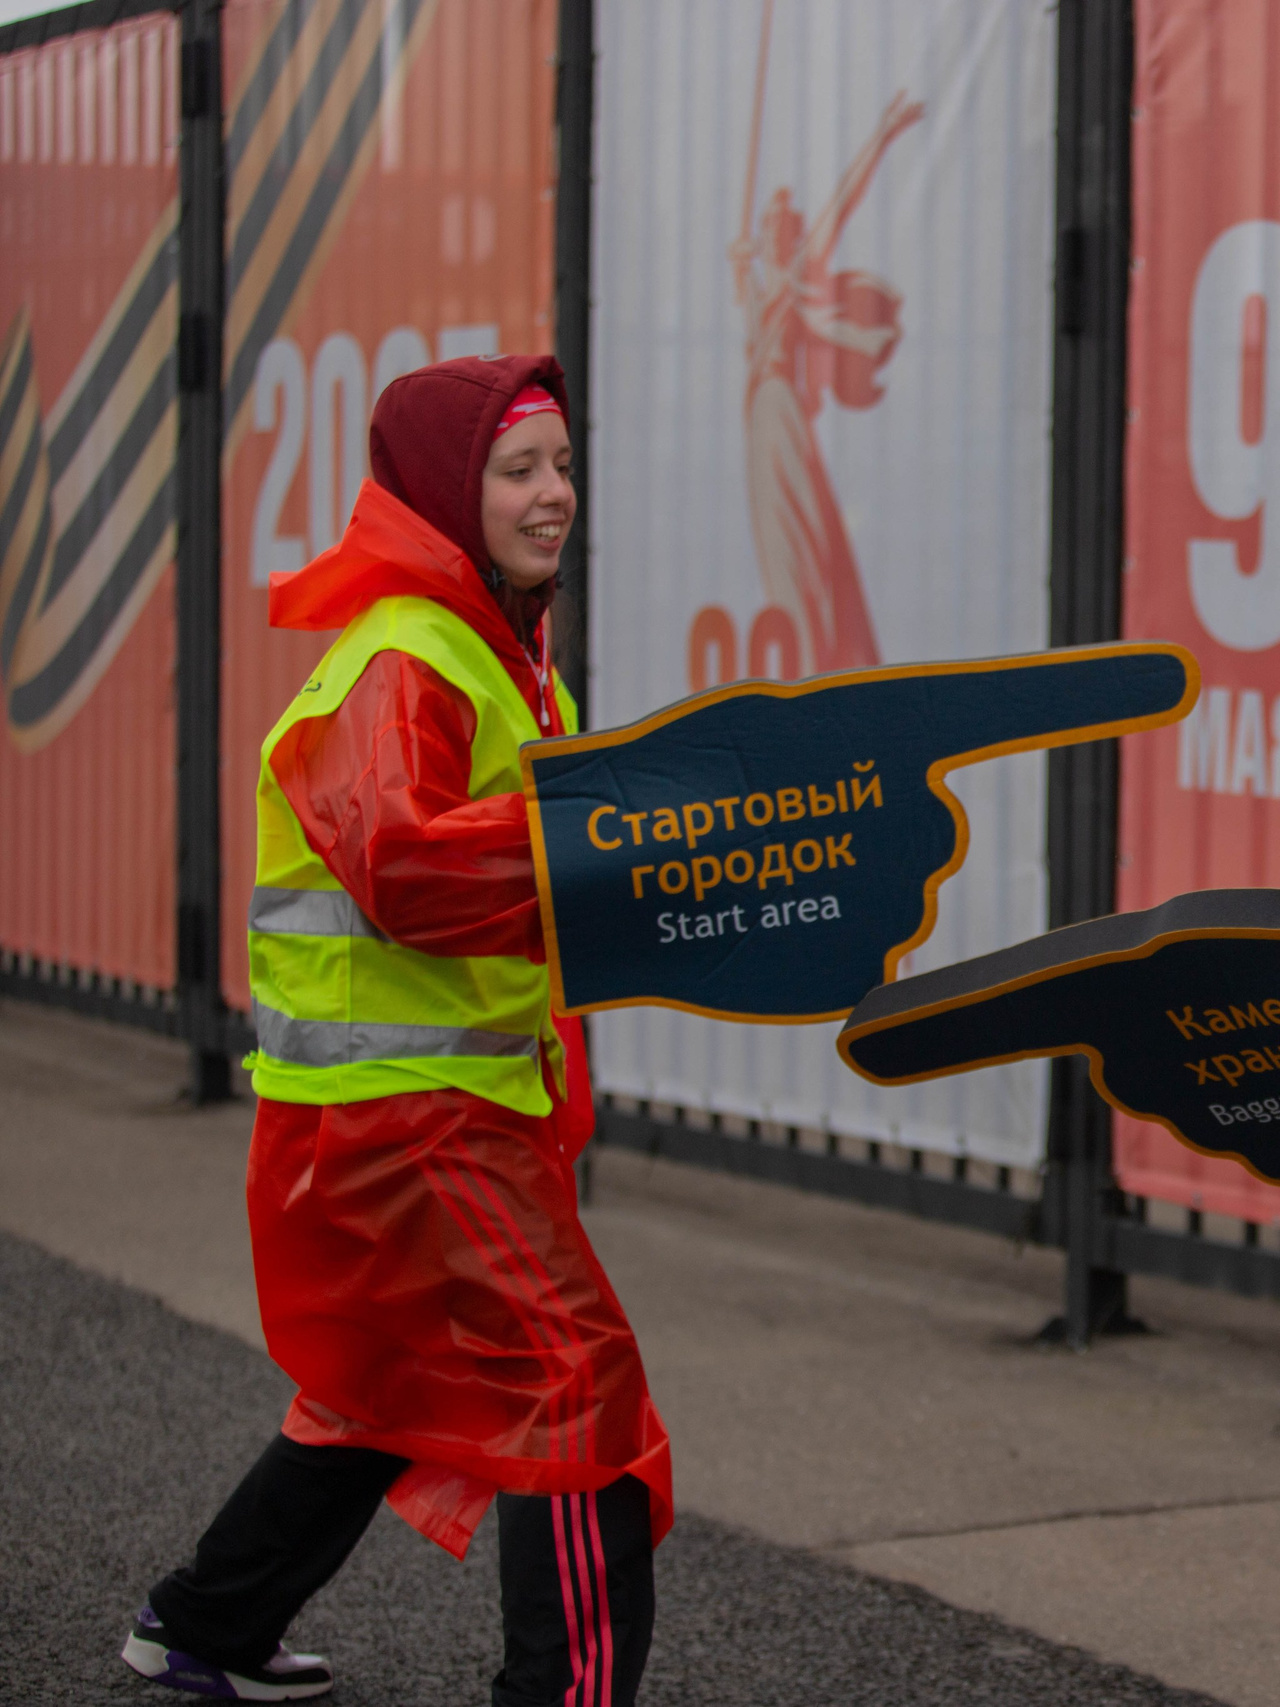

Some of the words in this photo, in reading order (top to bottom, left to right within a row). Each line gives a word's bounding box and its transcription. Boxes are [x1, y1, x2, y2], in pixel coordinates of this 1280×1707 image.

[253, 325, 498, 588] 20
[586, 759, 884, 850] Стартовый
[631, 832, 857, 902] городок
[657, 905, 749, 944] Start
[760, 895, 842, 930] area
